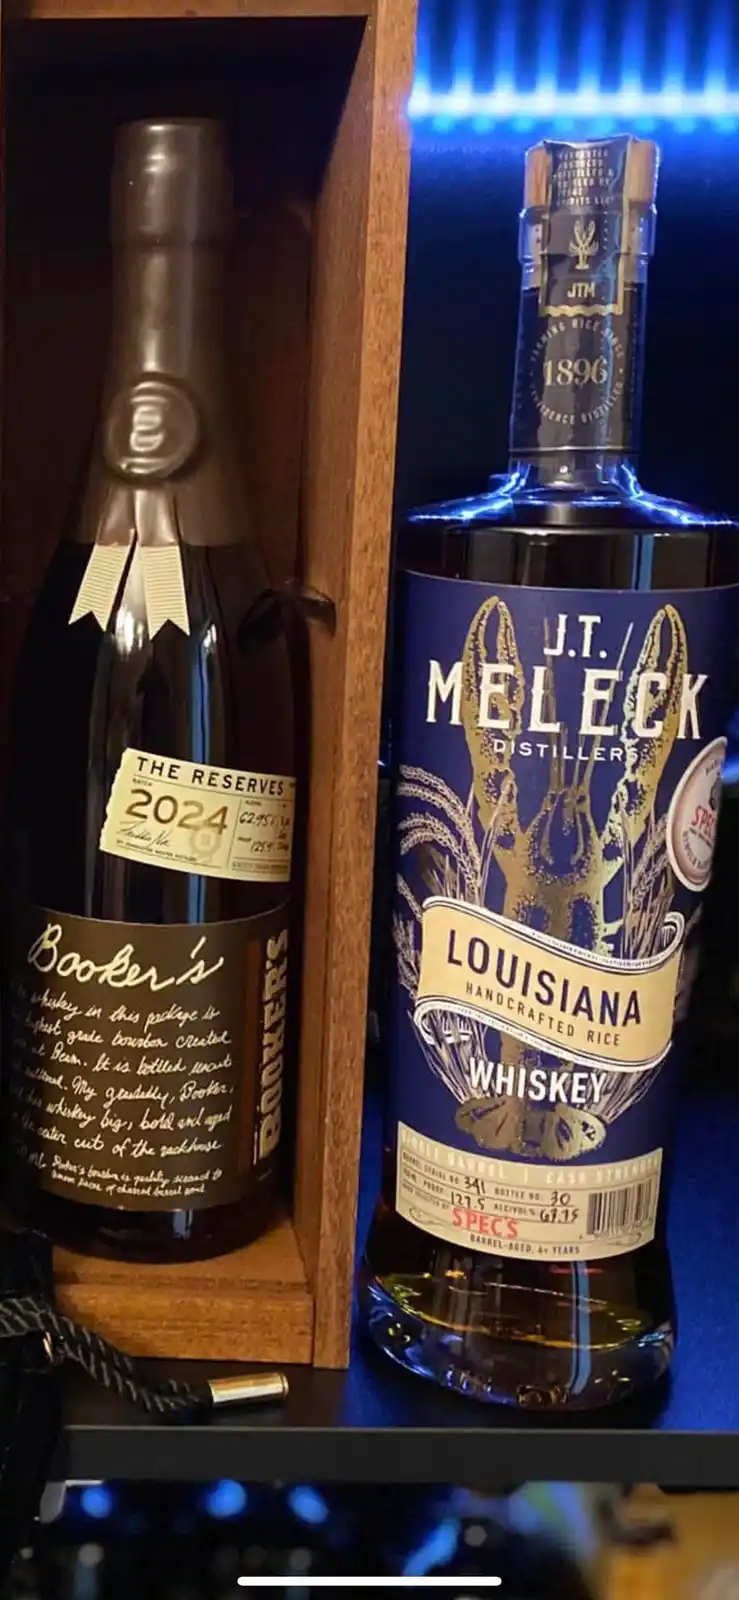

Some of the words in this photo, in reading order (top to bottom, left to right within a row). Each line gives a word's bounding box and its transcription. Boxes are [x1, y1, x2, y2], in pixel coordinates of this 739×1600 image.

[567, 282, 595, 298] JTM
[572, 318, 600, 332] RICE
[543, 357, 608, 386] 1896
[543, 614, 607, 658] J.T.
[426, 660, 710, 739] MELECK
[493, 740, 639, 762] DISTILLERS
[137, 756, 181, 780] THE
[191, 769, 285, 796] RESERVES
[125, 788, 229, 836] 2024
[28, 923, 225, 991] Booker's
[447, 929, 642, 1027] LOUISIANA
[84, 1005, 102, 1019] in
[108, 1004, 140, 1024] this
[143, 1003, 198, 1034] package
[466, 981, 575, 1037] HANDCRAFTED
[587, 1030, 621, 1047] RICE
[66, 1030, 104, 1045] grade
[111, 1030, 168, 1048] bourbon
[175, 1030, 232, 1048] created
[92, 1052, 112, 1072] It
[113, 1056, 131, 1073] is
[136, 1055, 187, 1075] bottled
[72, 1075, 98, 1102] My
[469, 1057, 608, 1104] WHISKEY
[45, 1096, 96, 1129] whiskey
[100, 1108, 133, 1133] big,
[140, 1107, 175, 1131] bold
[177, 1106, 205, 1129] and
[204, 1104, 233, 1132] aged
[74, 1133, 105, 1151] cut
[112, 1137, 132, 1158] of
[130, 1138, 156, 1158] the
[447, 1152, 507, 1179] BARREL
[546, 1170, 587, 1184] CASK
[450, 1191, 485, 1210] 127.5
[464, 1175, 485, 1196] 341
[550, 1189, 571, 1207] 30
[552, 1245, 580, 1255] YEARS
